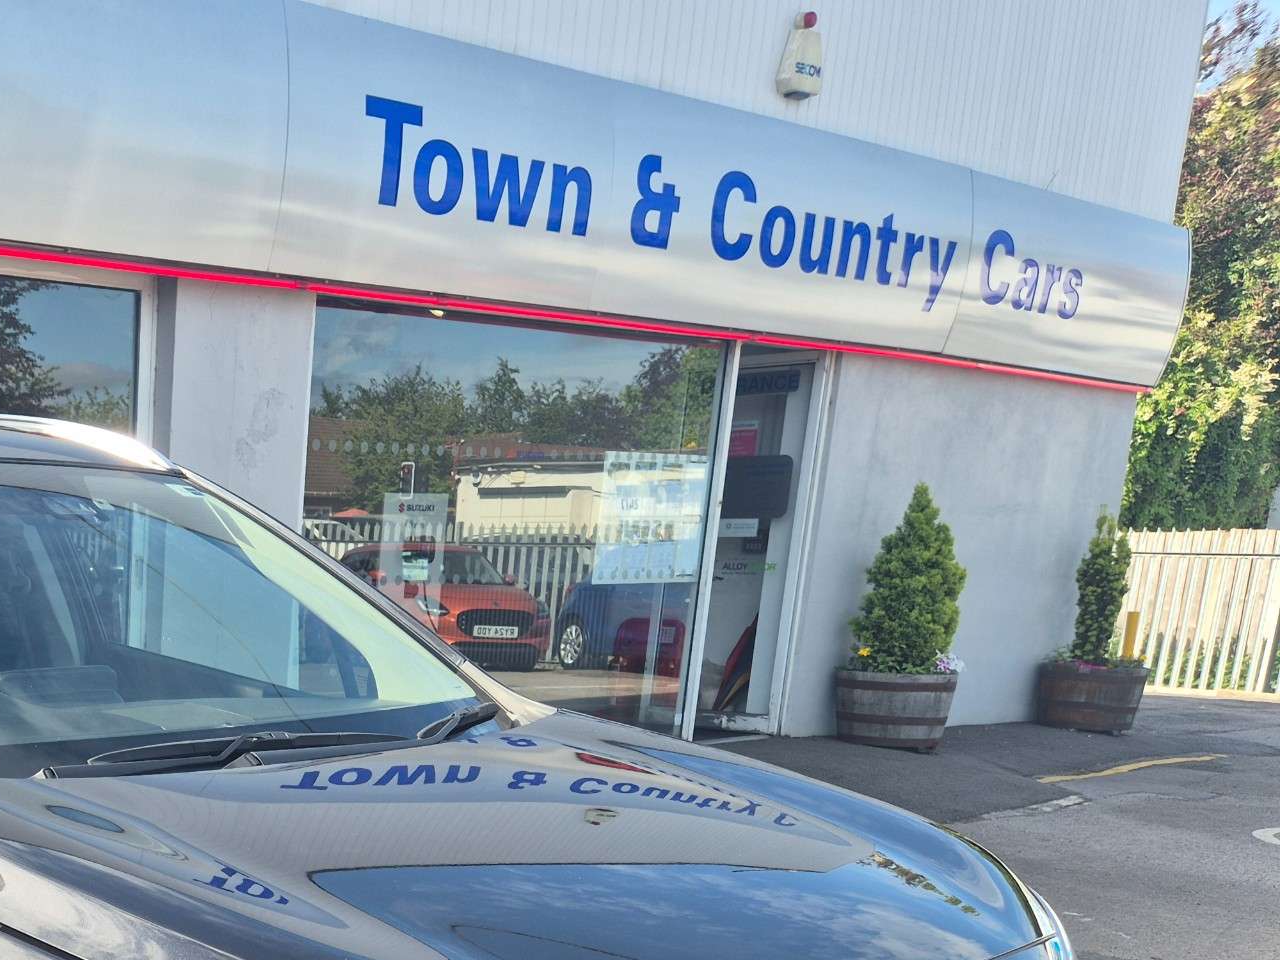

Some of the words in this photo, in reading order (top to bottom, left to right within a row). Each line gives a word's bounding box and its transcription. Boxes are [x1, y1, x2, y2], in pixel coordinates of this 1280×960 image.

[365, 94, 593, 237] Town
[630, 154, 681, 250] &
[710, 170, 958, 313] Country
[979, 229, 1083, 320] Cars
[407, 503, 435, 512] SUZUKI
